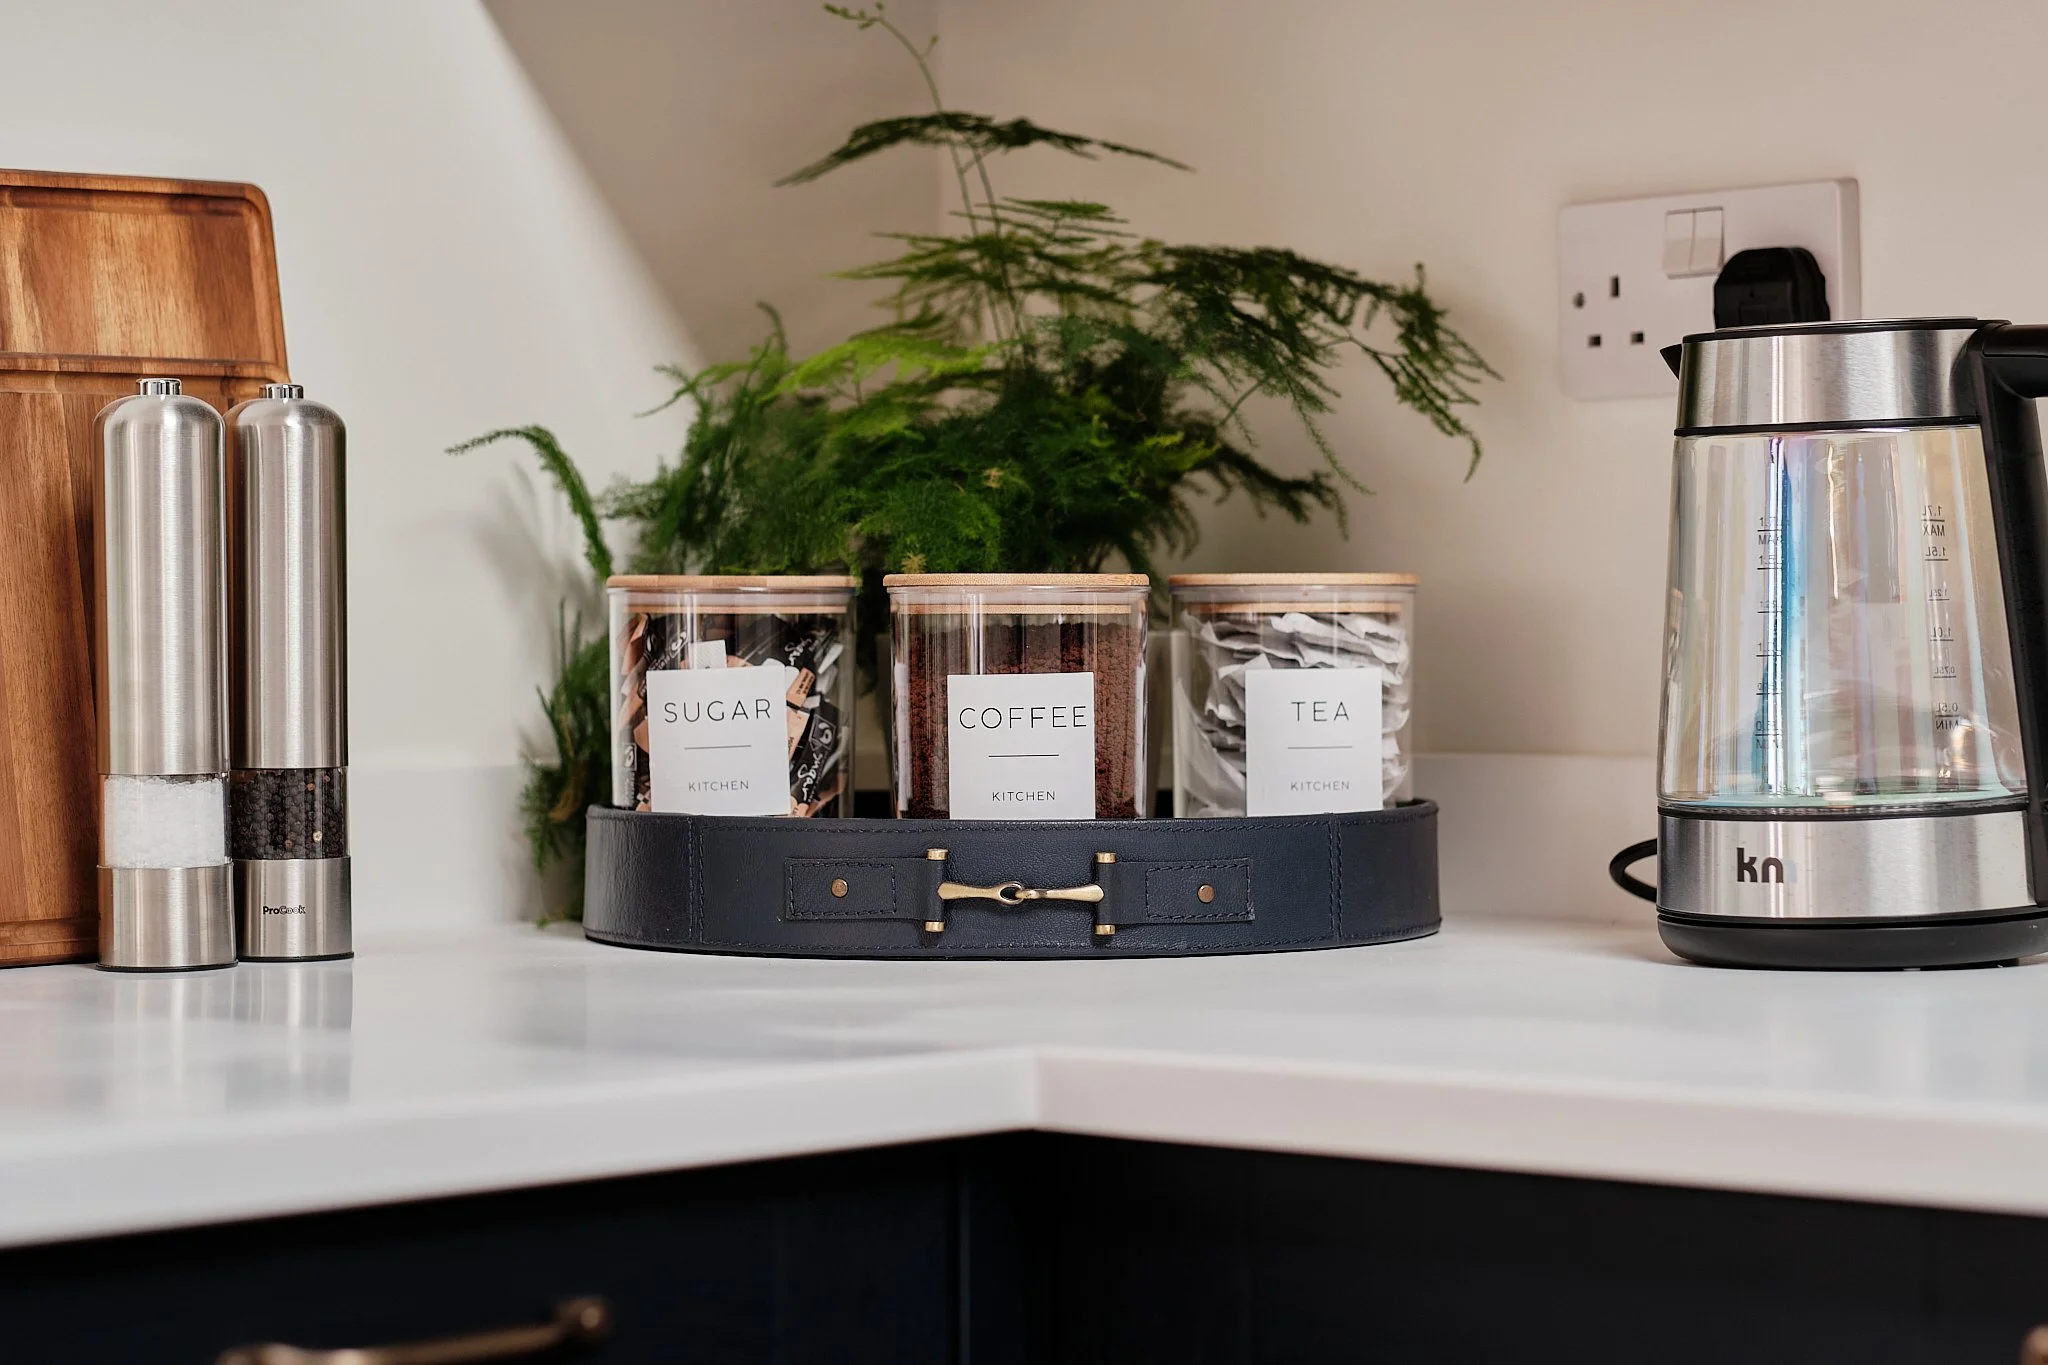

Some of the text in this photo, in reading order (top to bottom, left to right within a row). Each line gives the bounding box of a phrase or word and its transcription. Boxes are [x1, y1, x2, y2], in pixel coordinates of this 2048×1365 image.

[663, 698, 771, 724] SUGAR
[959, 705, 1088, 730] COFFEE
[1290, 701, 1350, 722] TEA
[687, 779, 750, 793] KITCHEN
[1290, 781, 1350, 792] KITCHEN
[992, 790, 1057, 802] KITCHEN
